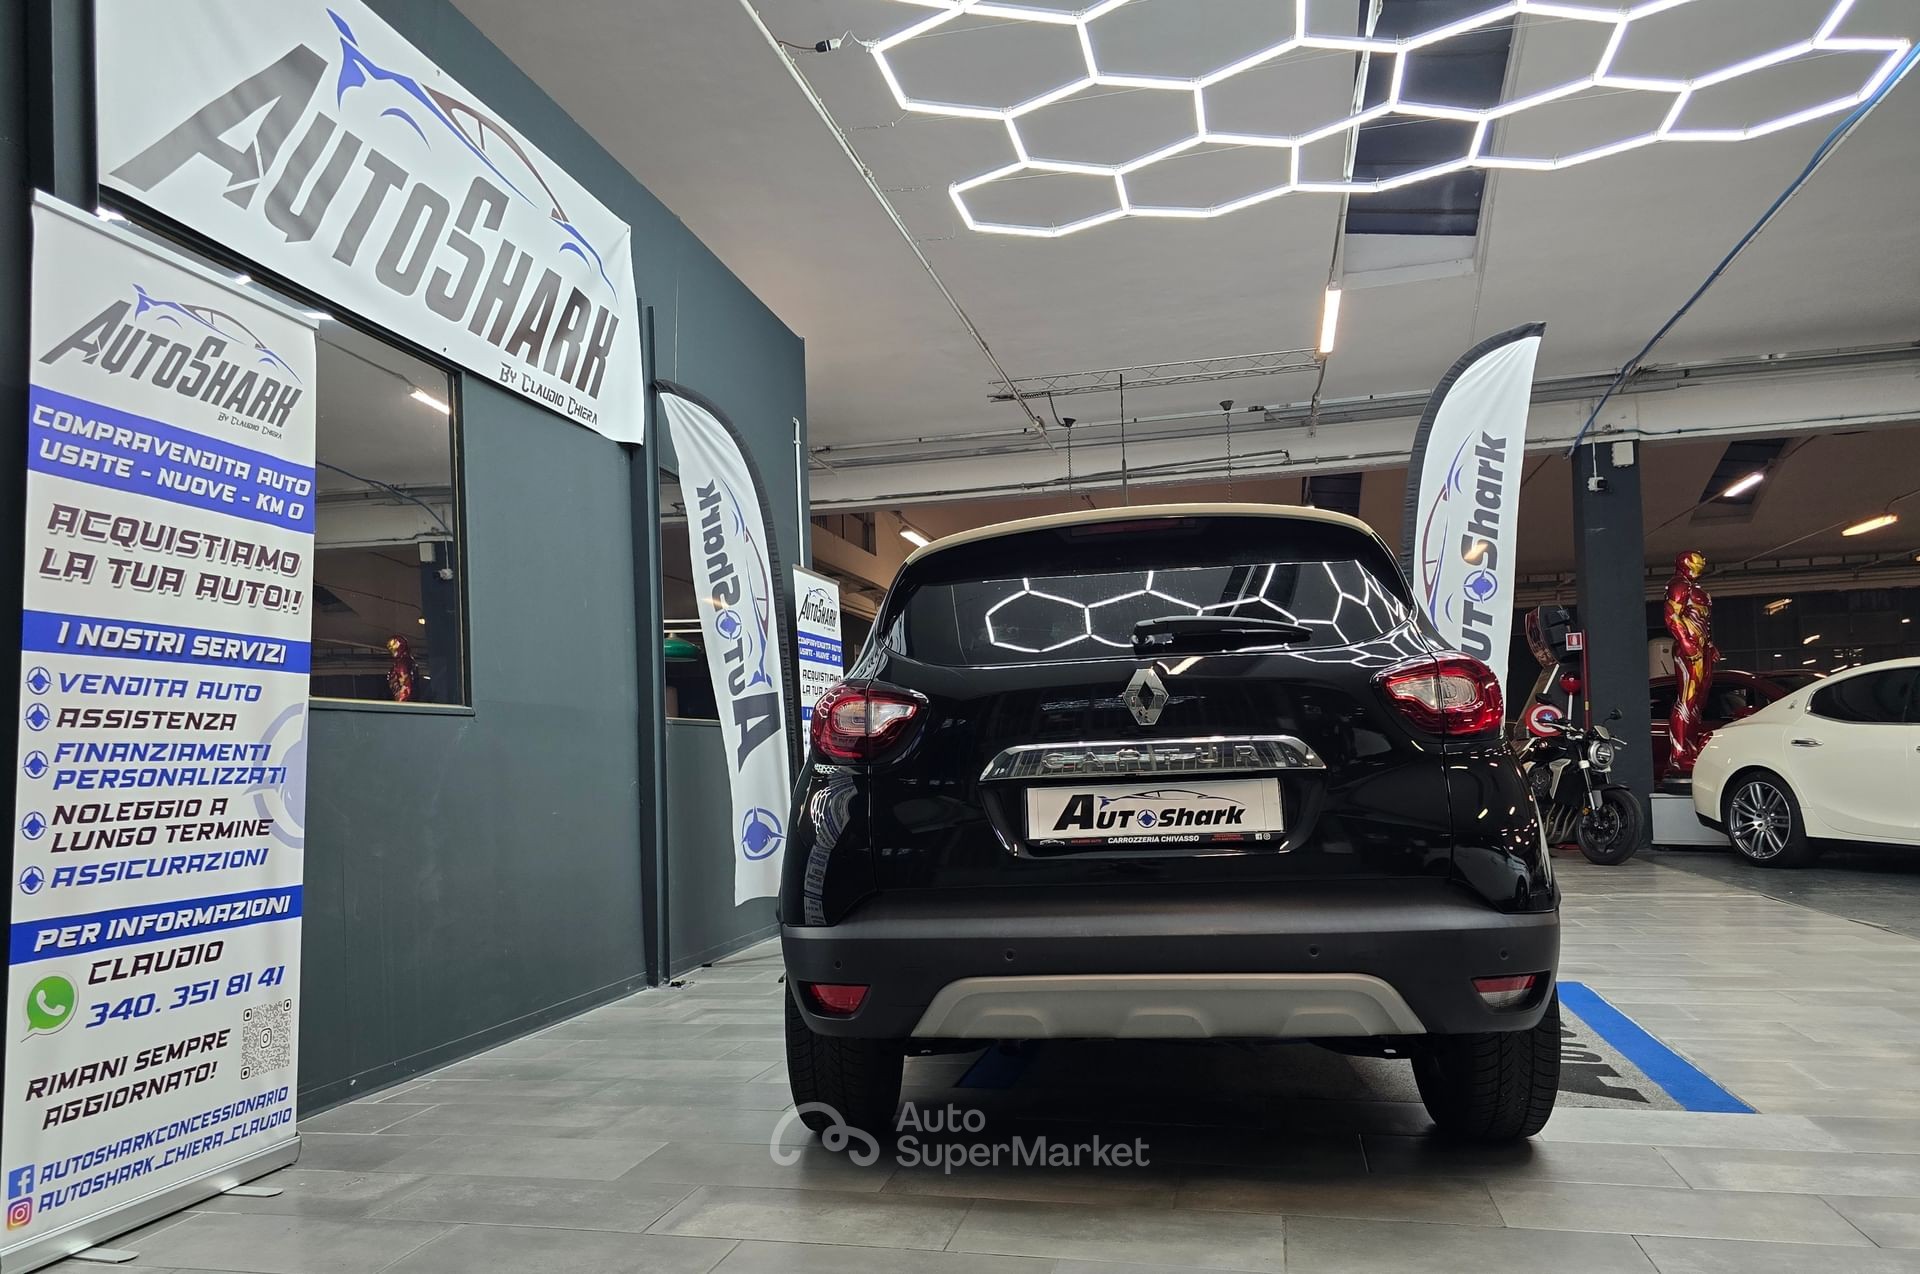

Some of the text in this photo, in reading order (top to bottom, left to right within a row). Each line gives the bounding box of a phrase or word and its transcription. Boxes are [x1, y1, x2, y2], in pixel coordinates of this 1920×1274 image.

[521, 372, 565, 408] CLAUDIO
[567, 395, 598, 425] CHIERA
[32, 403, 312, 498] COMPRAVENDITA AUTO
[39, 438, 132, 479] USATE
[156, 468, 238, 504] NUOVE
[256, 492, 284, 515] KM
[46, 502, 302, 577] ACQUISTIAMO
[38, 546, 304, 615] LA TUA AUTO!!
[57, 621, 287, 665] I NOSTRI SERVIZI
[58, 671, 263, 702] VENDITA AUTO
[56, 707, 238, 731] ASSISTENZA
[52, 766, 287, 791] PERSONALIZZATI
[54, 742, 272, 764] FINANZIAMENTI
[50, 818, 275, 854] LUNGO TERMINE
[51, 797, 229, 826] NOLEGGIO A
[1107, 835, 1159, 844] CARROZZERIA
[1161, 835, 1199, 843] CHIVASSO
[50, 848, 270, 889] ASSICURAZIONI
[33, 895, 291, 953] PER INFORMAZIONI
[88, 940, 225, 986] CLAUDIO
[85, 965, 285, 1030] 340. 351 81 41
[26, 1028, 231, 1102] RIMANI SEMPRE
[42, 1061, 218, 1131] AGGIORNATO!
[38, 1107, 292, 1213] AUTOSHARK_CHIERA_CLAUDIO
[39, 1086, 289, 1185] AUTOSHARKCONCESSIONARIO
